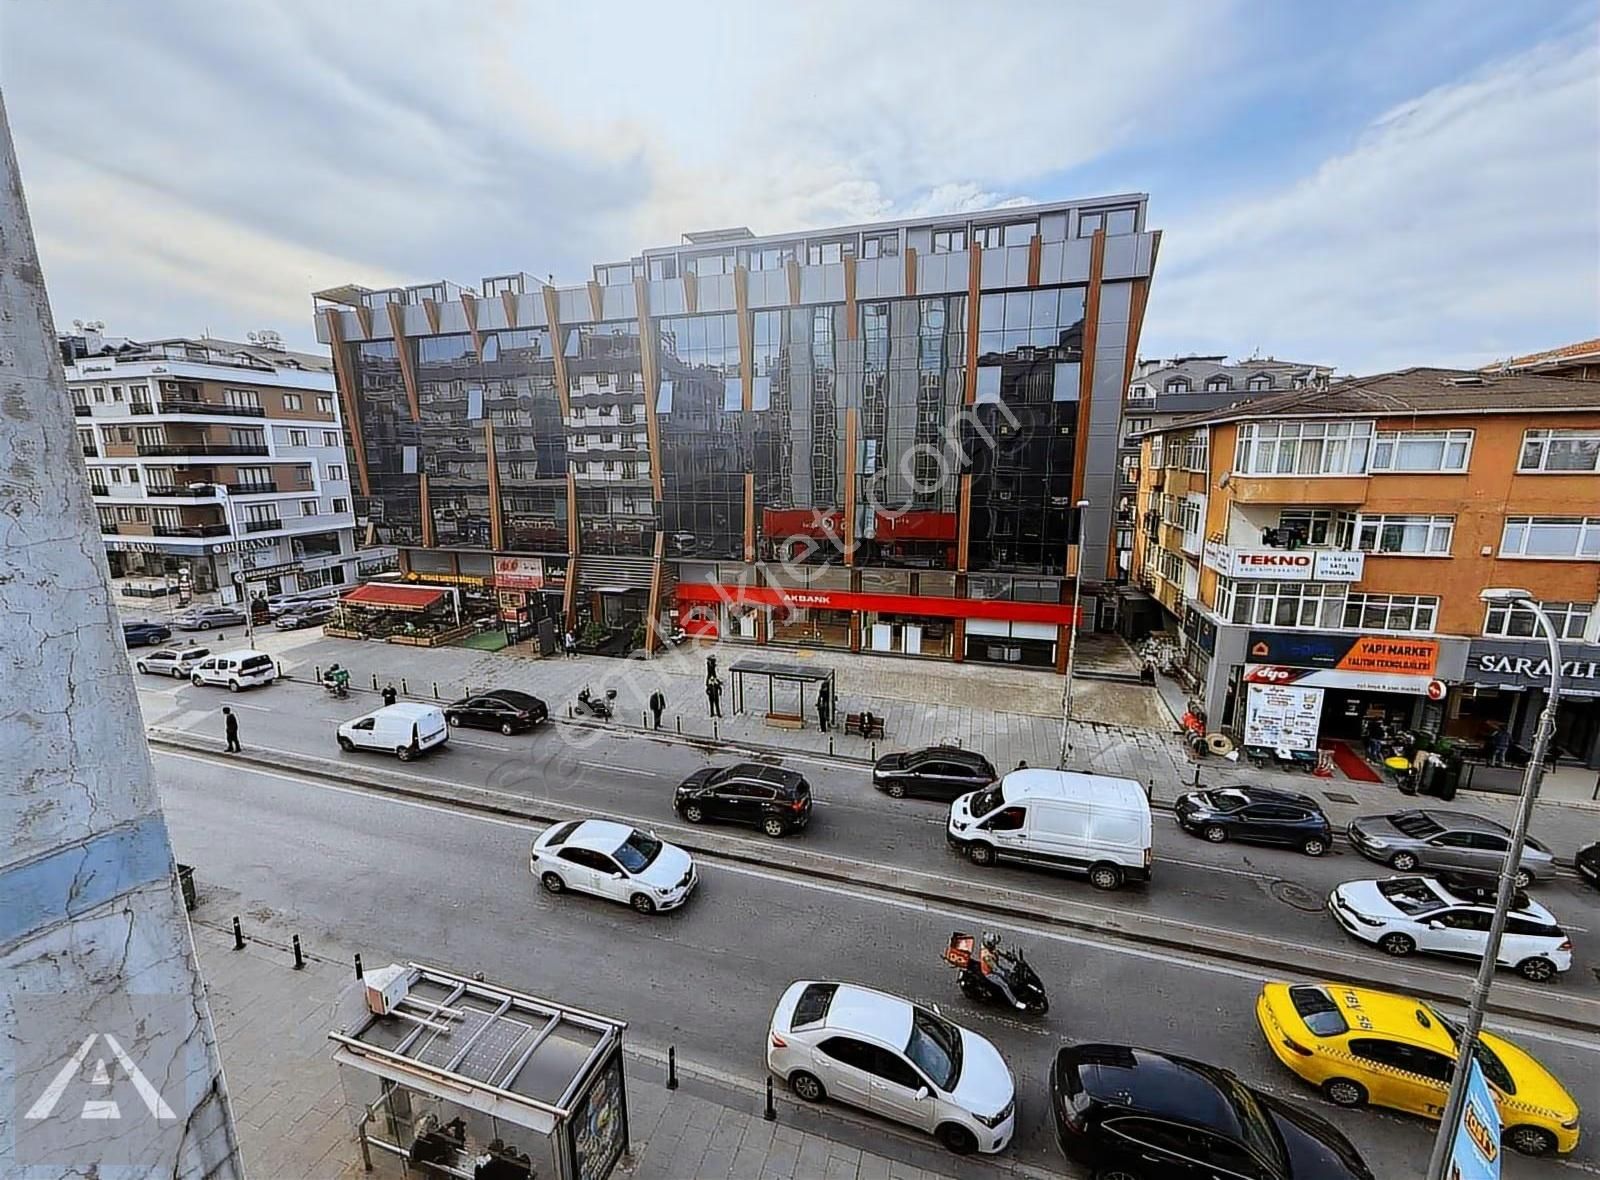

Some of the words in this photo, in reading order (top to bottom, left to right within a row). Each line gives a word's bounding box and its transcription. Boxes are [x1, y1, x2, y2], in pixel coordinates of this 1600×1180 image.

[1238, 554, 1311, 567] TEKNO
[783, 593, 831, 604] AKBANK
[1361, 643, 1386, 654] YAPI
[1387, 645, 1433, 657] MARKET
[1257, 667, 1289, 681] dyo
[1479, 655, 1597, 679] SARAYLI
